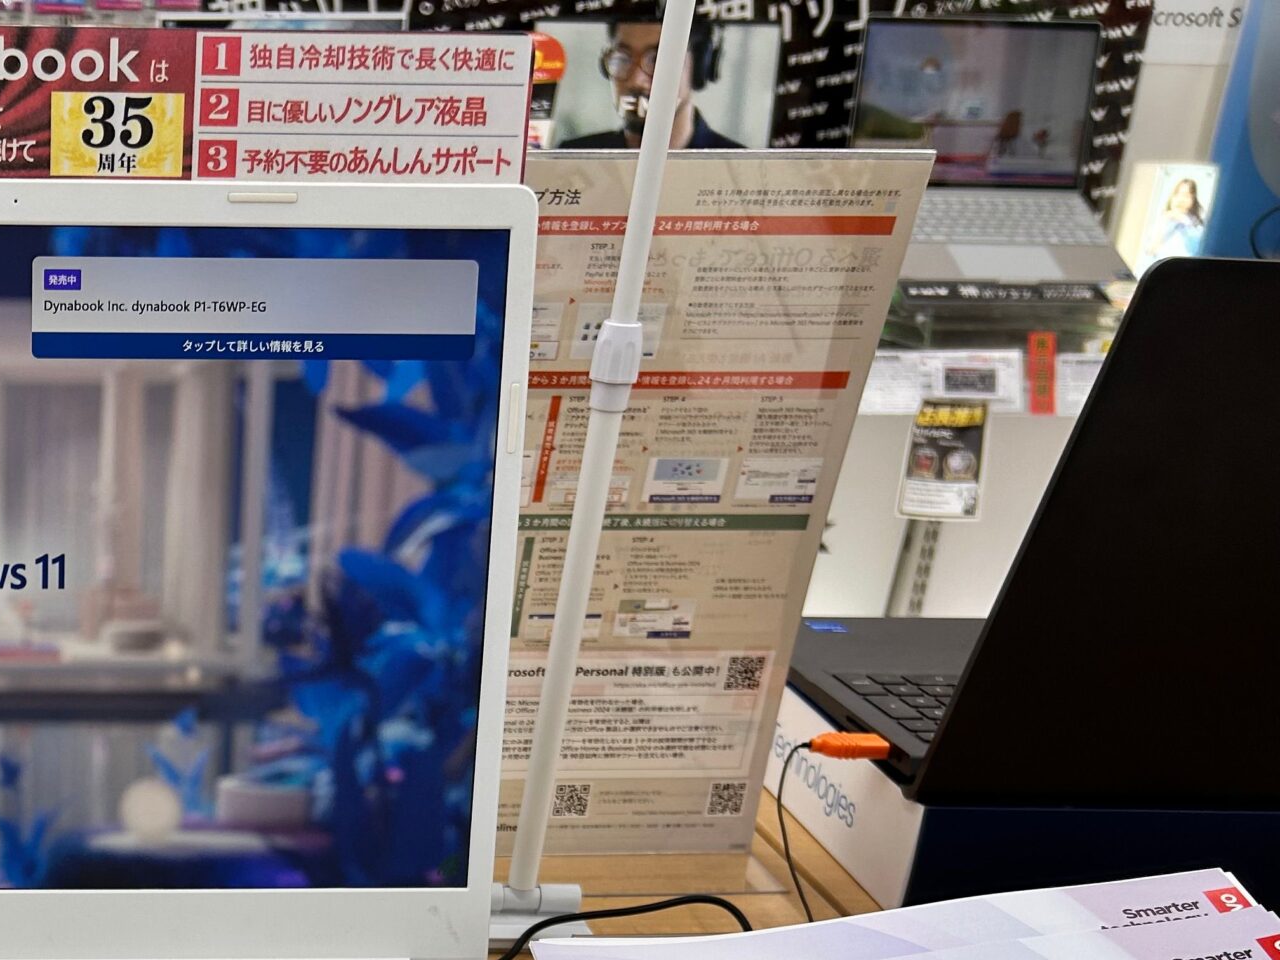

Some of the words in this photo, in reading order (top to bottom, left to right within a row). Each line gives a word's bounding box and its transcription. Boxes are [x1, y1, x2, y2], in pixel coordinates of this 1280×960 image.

[1150, 7, 1222, 27] crosoft
[213, 42, 229, 70] 1
[249, 44, 515, 72] 独自冷却技術で長く快適に
[149, 59, 169, 83] は
[208, 93, 231, 120] 2
[247, 96, 487, 127] 目に優しいノングレア液晶
[81, 96, 154, 149] 35
[97, 153, 137, 173] 周年
[206, 145, 228, 171] 3
[242, 146, 511, 175] 予約不要のあんしんサポート
[48, 274, 77, 286] 発売中
[43, 300, 104, 313] Dynabook
[107, 300, 128, 312] Inc.
[131, 300, 190, 314] dynabook
[194, 301, 267, 313] P1-T6WP-EG
[182, 340, 324, 354] タップして詳しい情報を見る
[35, 553, 66, 590] 11
[575, 666, 628, 678] Personal
[774, 733, 857, 828] echnologies
[1122, 901, 1200, 919] Smarter
